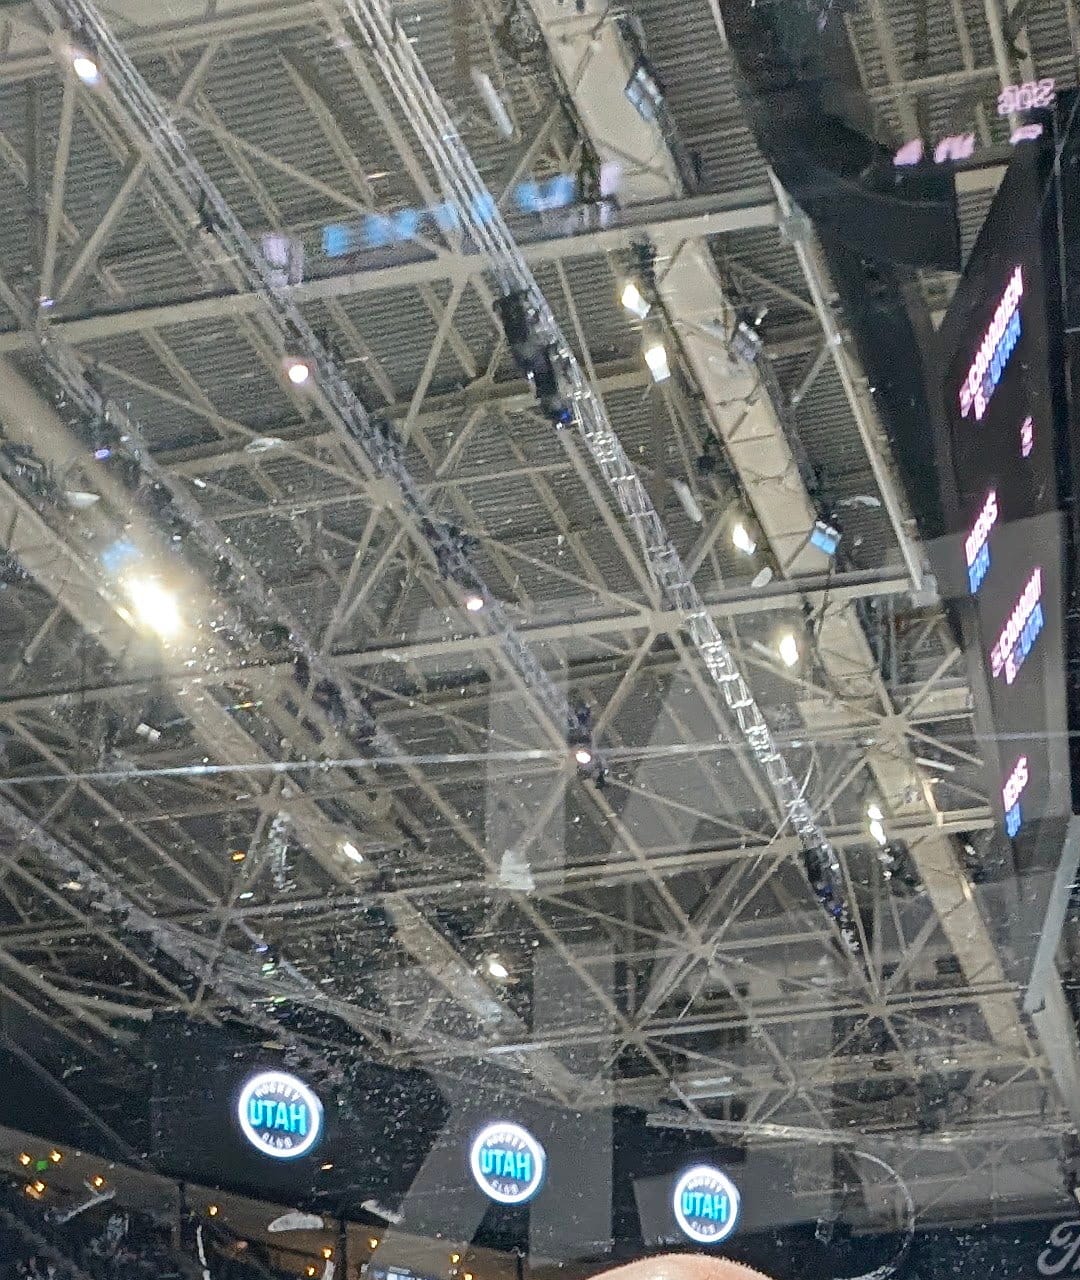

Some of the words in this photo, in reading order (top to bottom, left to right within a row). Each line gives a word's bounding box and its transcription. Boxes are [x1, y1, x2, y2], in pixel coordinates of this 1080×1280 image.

[249, 1099, 306, 1136] UTAH
[481, 1148, 531, 1182] UTAH
[683, 1192, 727, 1223] UTAH
